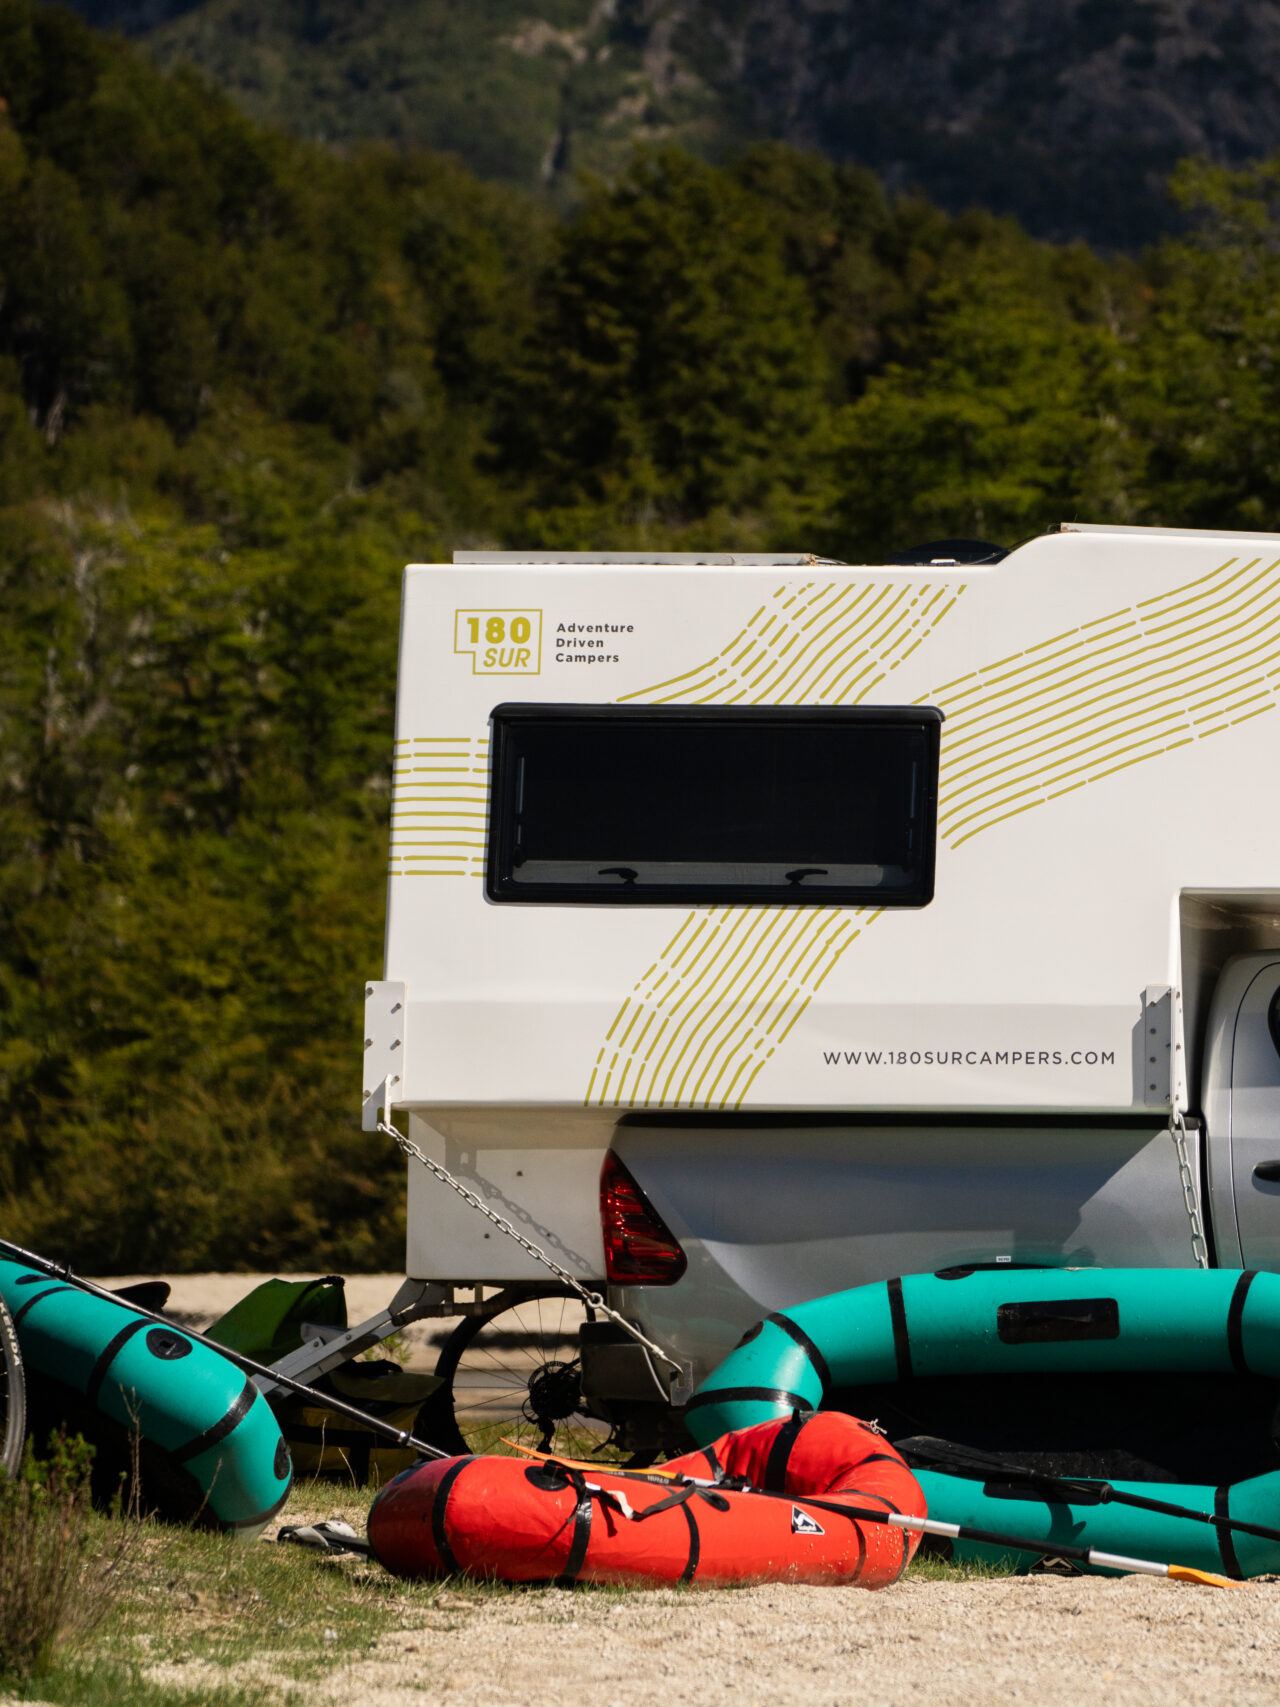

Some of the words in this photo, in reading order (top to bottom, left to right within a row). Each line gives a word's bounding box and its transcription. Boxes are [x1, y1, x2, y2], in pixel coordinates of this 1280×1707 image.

[466, 616, 532, 645] 180
[556, 622, 635, 634] Adventure
[555, 637, 605, 648] Driven
[483, 647, 532, 668] SUR
[555, 652, 620, 664] Campers
[823, 1051, 1116, 1065] WWW.180SURCAMPERS.COM
